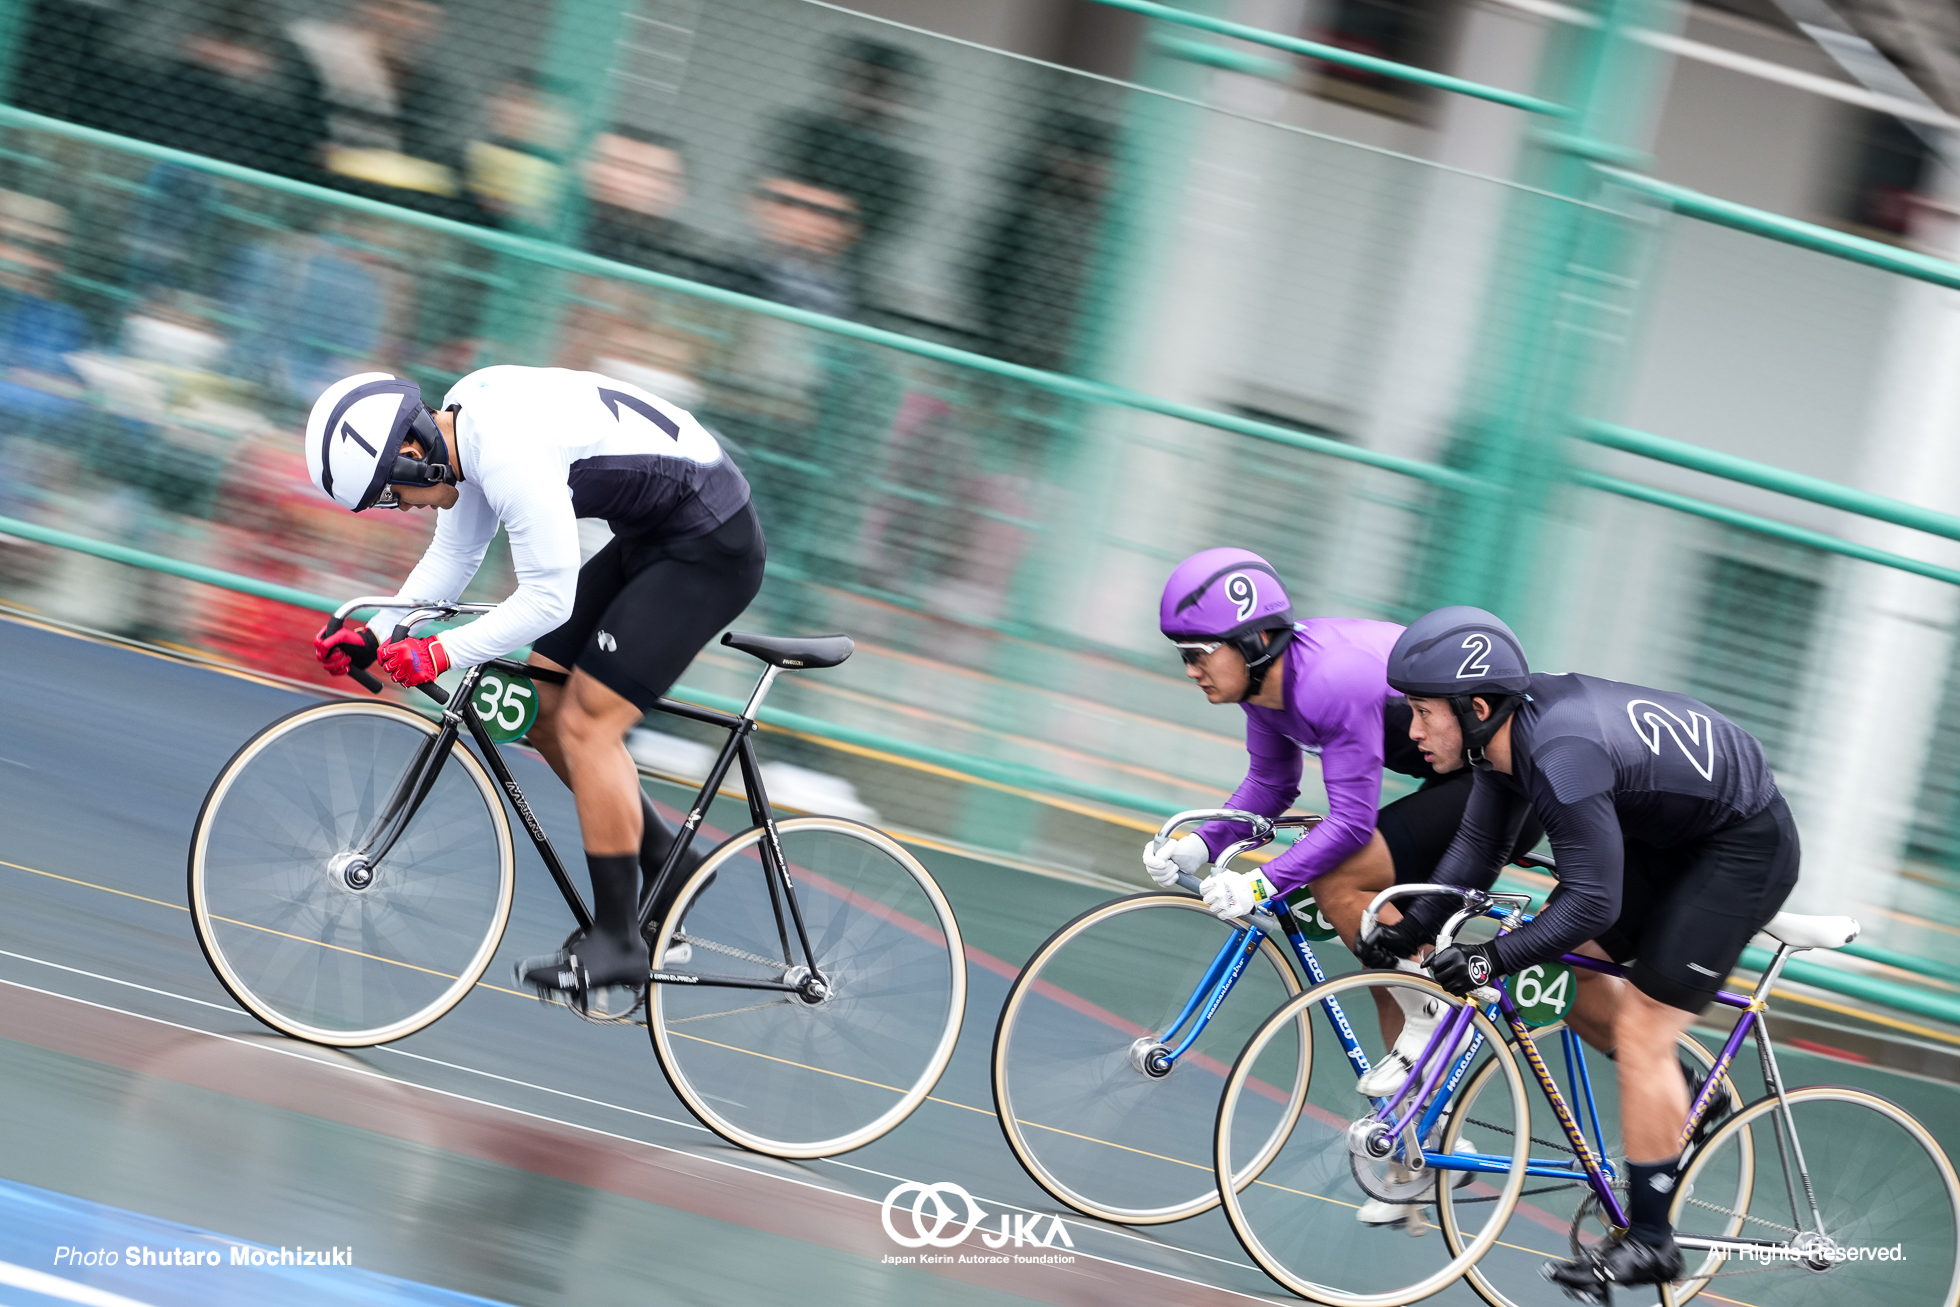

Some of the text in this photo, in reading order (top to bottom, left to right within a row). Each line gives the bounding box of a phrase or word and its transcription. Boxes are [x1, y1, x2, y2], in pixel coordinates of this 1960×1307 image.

[597, 386, 680, 442] 1
[341, 421, 378, 459] 1
[1224, 572, 1258, 622] 9
[1455, 633, 1492, 679] 2
[472, 675, 532, 731] 35
[1627, 699, 1714, 782] 2
[1515, 964, 1570, 1015] 64
[1347, 1046, 1372, 1077] gir
[1511, 1021, 1602, 1174] BRIDGESTONE
